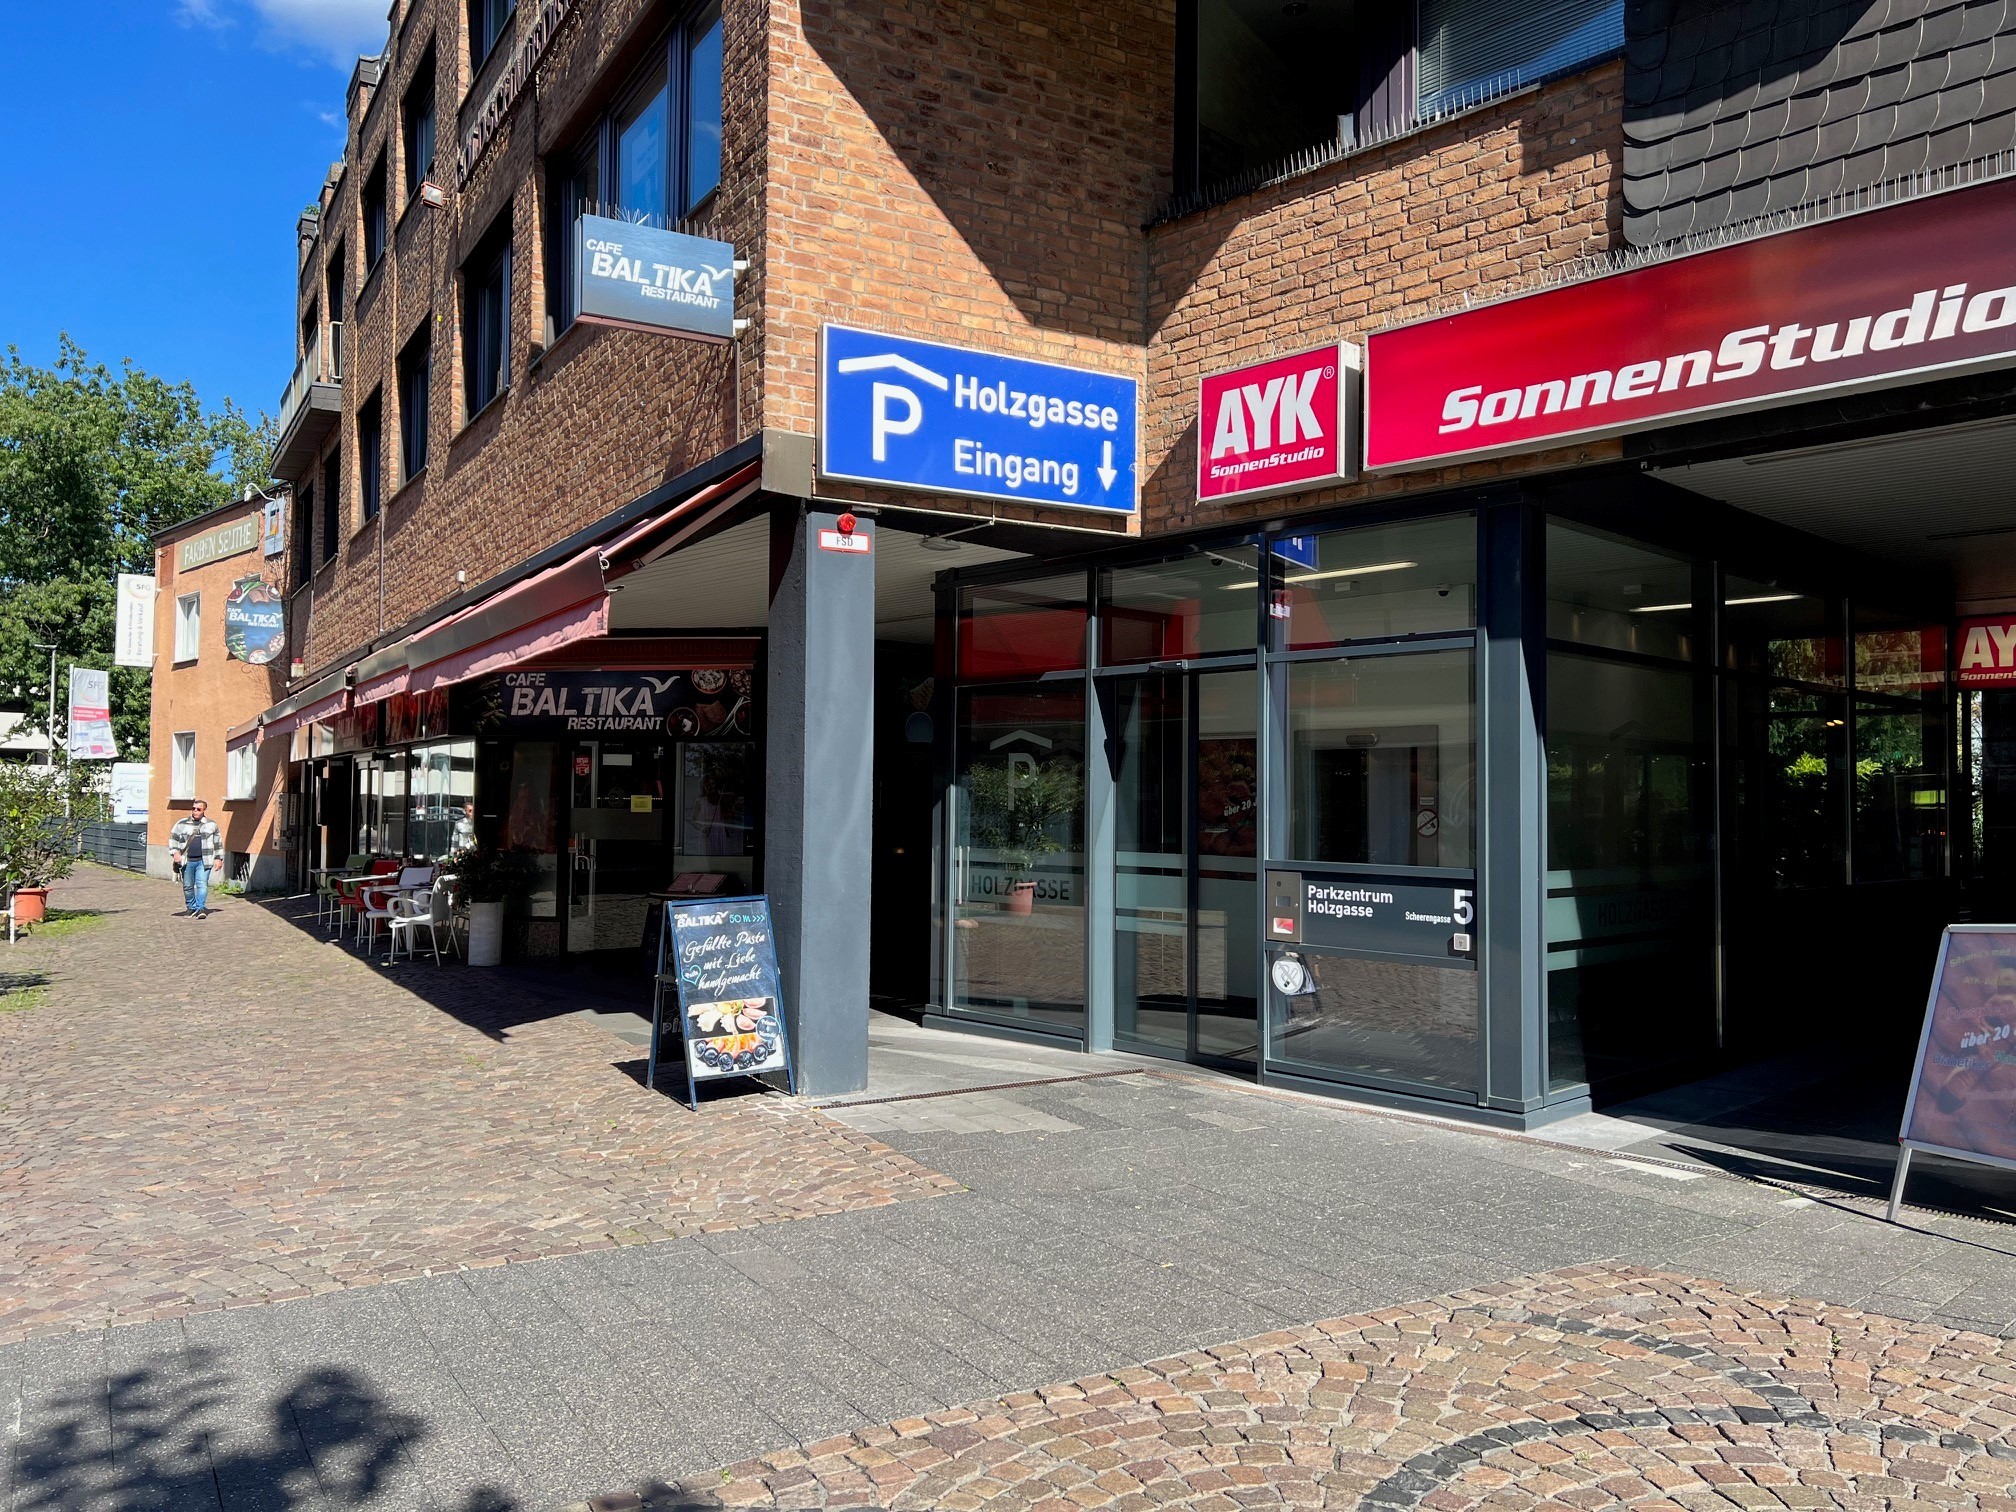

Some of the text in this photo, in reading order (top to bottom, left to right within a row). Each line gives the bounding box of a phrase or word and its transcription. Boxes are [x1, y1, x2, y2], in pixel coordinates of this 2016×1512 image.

[586, 238, 623, 255] CAFE
[591, 252, 713, 297] BALTIKA
[641, 284, 720, 309] RESTAURANT
[1438, 282, 2016, 435] SonnenStudio
[953, 372, 1118, 432] Holzgasse
[872, 382, 922, 462] P
[953, 439, 1079, 495] Eingang
[1210, 445, 1325, 479] SonnenStudio
[184, 537, 216, 565] FARBEN
[836, 537, 853, 546] FSD
[229, 612, 277, 623] BALTIKA
[505, 673, 546, 687] CAFE
[511, 687, 655, 716] BALTIKA
[567, 717, 664, 730] RESTAURANT
[1241, 799, 1252, 811] 20
[1307, 885, 1393, 904] Parkzentrum
[1405, 889, 1474, 925] Scheerengasse 5
[677, 914, 722, 927] BALTIKA
[730, 915, 741, 924] 50
[1307, 900, 1373, 918] Holzgasse
[683, 931, 765, 963] Gefüllte Pasta
[703, 946, 756, 970] mit Liebe
[698, 964, 762, 997] handgemacht
[1960, 1032, 1991, 1049] über
[1993, 1024, 2010, 1042] 20
[1933, 1053, 1991, 1071] Diabetiker
